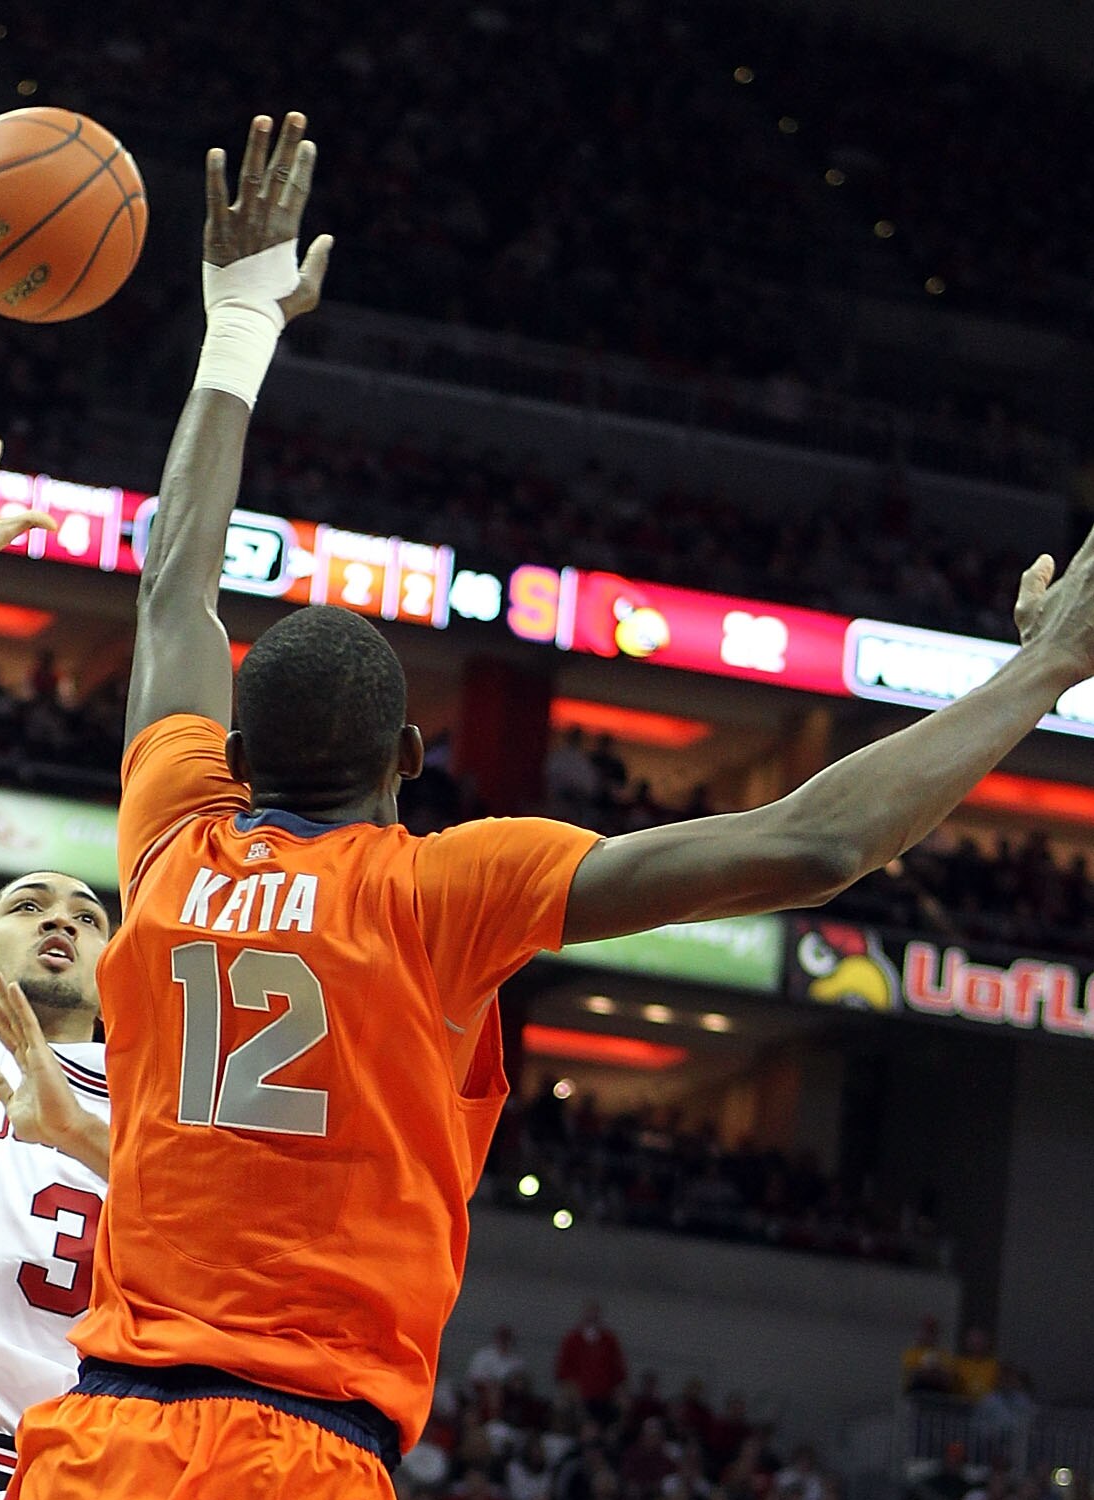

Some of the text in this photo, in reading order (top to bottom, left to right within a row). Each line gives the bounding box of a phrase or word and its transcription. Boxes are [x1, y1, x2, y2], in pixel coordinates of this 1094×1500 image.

[179, 866, 319, 933] KEITA
[171, 940, 329, 1138] 12
[904, 941, 1094, 1038] UofL
[17, 1182, 104, 1319] 3
